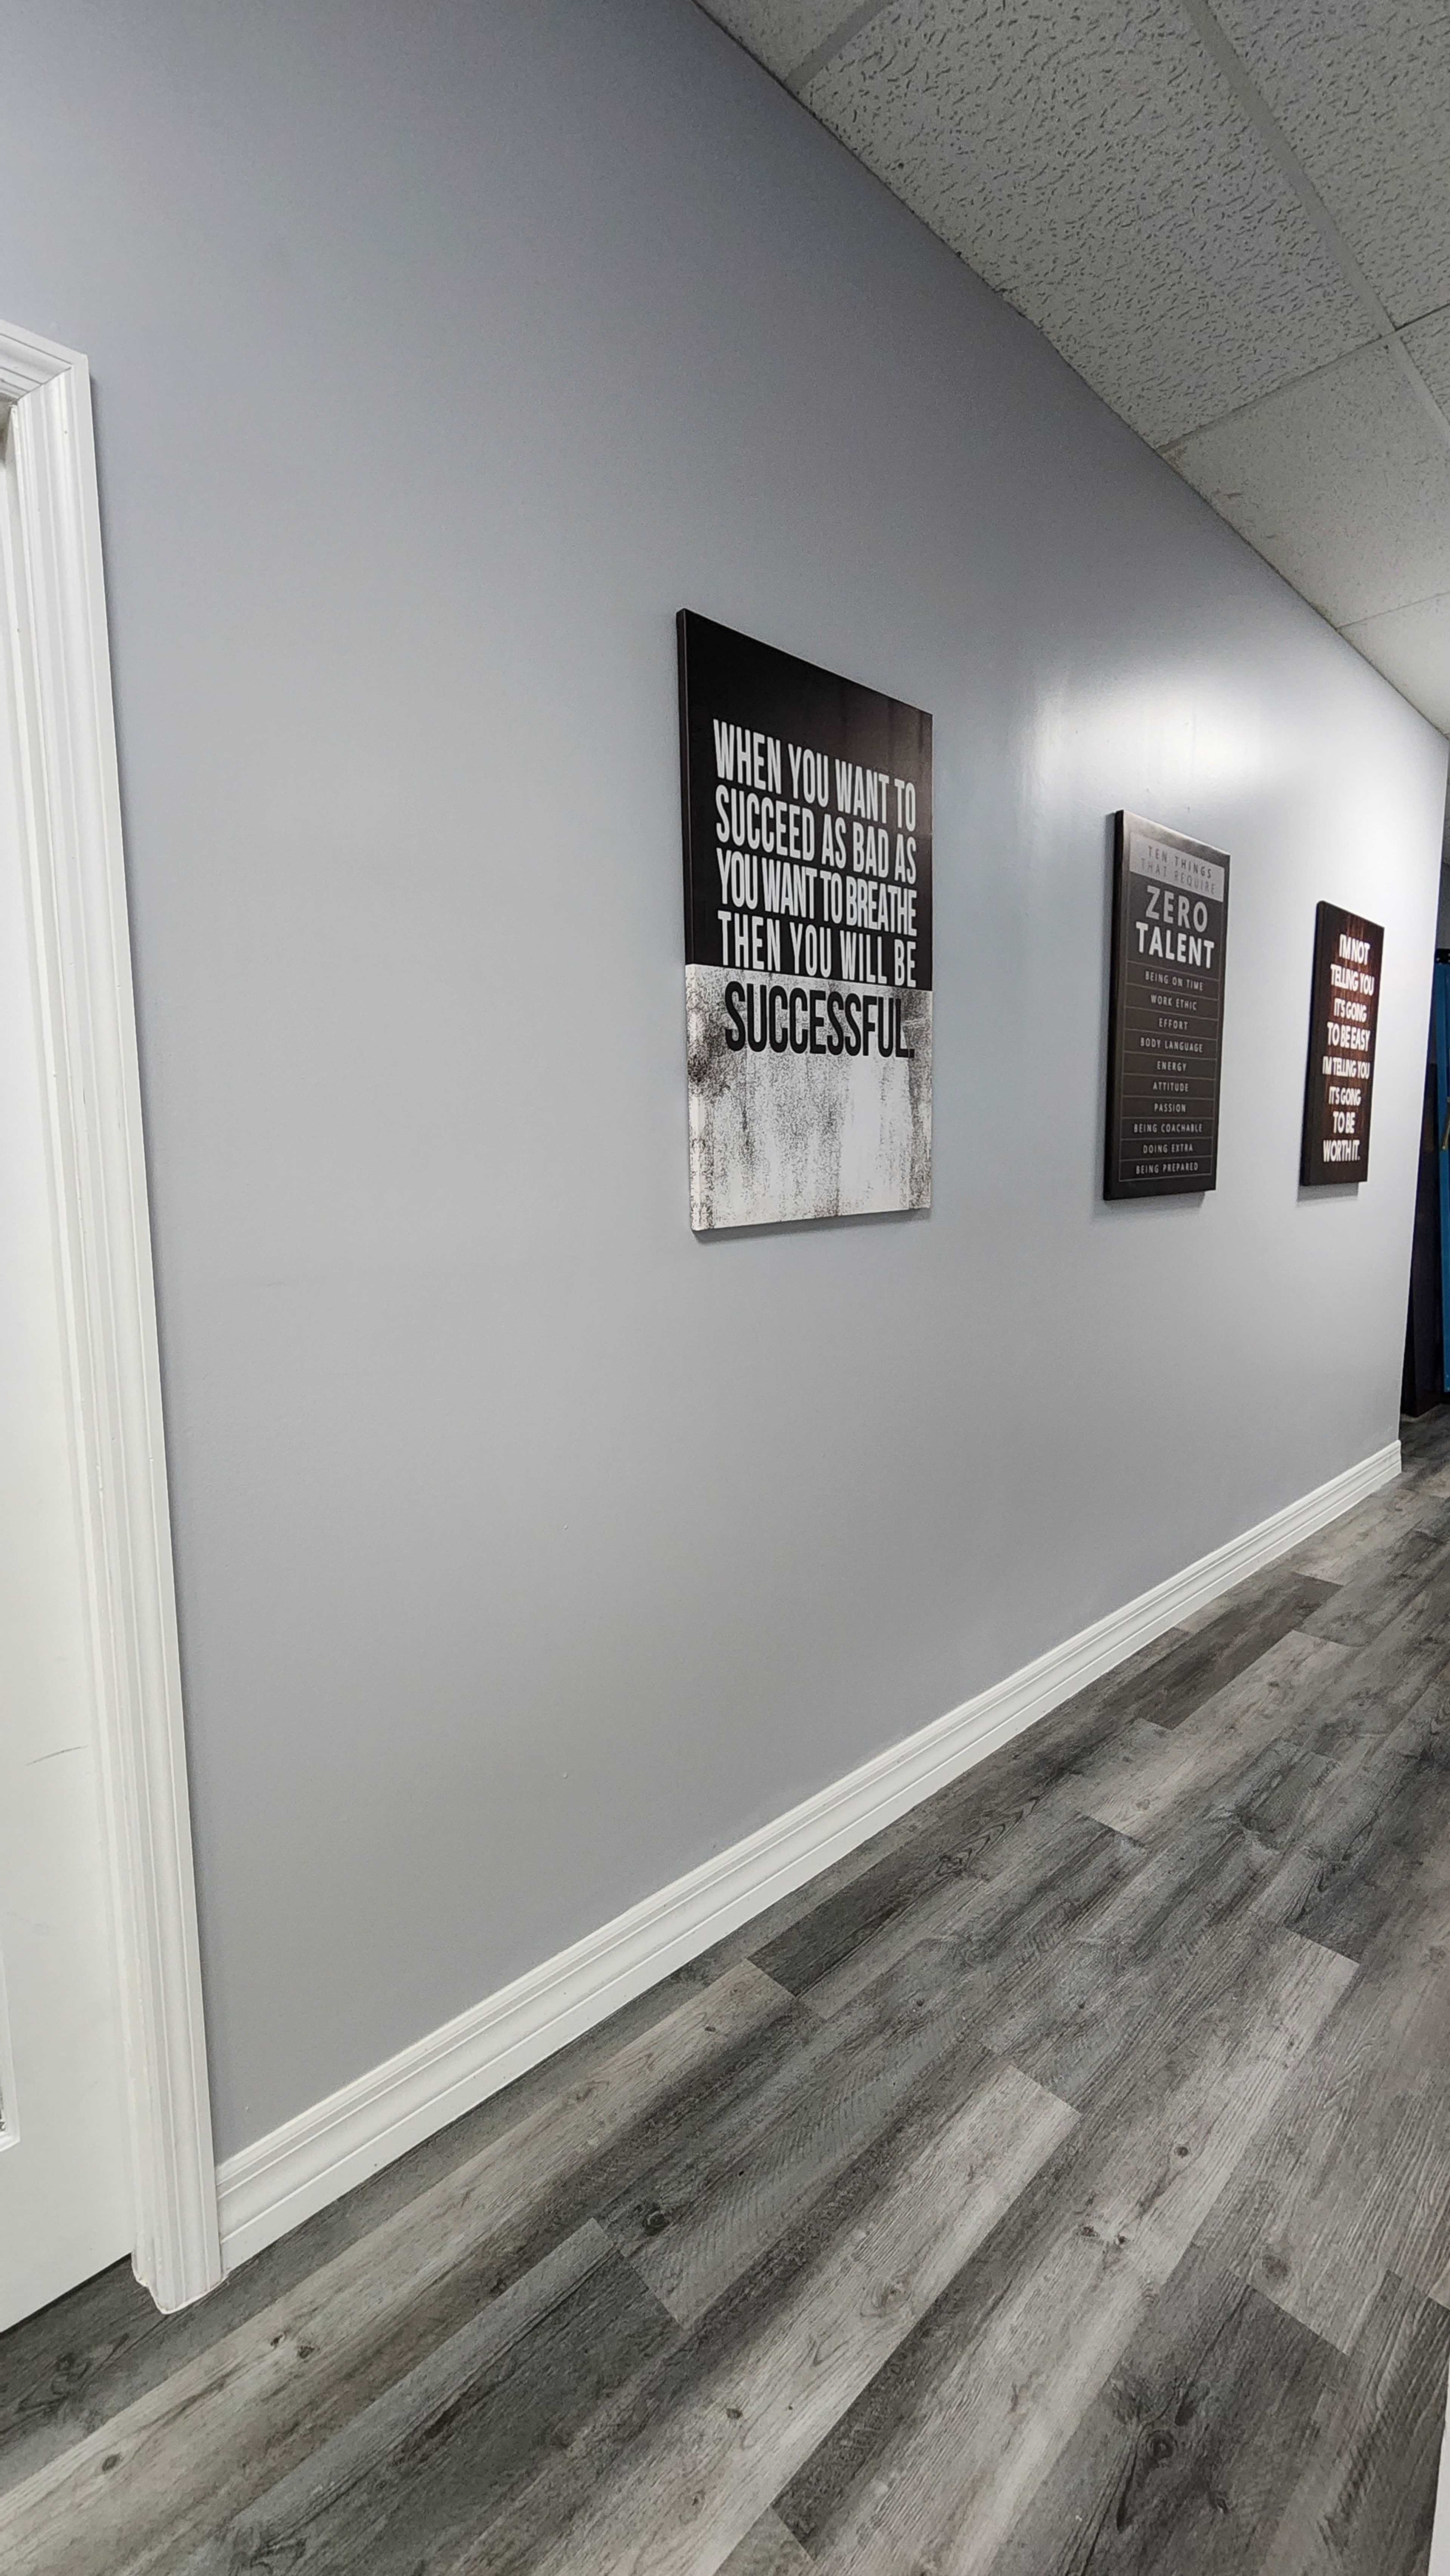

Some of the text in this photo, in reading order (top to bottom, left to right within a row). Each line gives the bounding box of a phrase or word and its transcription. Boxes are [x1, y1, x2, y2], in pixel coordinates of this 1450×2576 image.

[713, 719, 916, 831] WHEN YOU WANT TO
[715, 784, 916, 884] SUCCEED AS BAD AS
[1148, 845, 1212, 878] TEN THINGS
[1141, 858, 1215, 894] THAT REQUIRE
[716, 847, 917, 936] YOU WANT TO BREATHE
[1146, 885, 1208, 932] ZERO
[718, 911, 916, 987] THEN YOU WILL BE
[1136, 921, 1214, 969] TALENT
[1351, 938, 1370, 965] NOT
[1145, 971, 1203, 991] BEING ON TIME
[1330, 964, 1374, 996] TELLING YOU
[1151, 994, 1197, 1010] WORK ETHIC
[1346, 1001, 1367, 1022] GOING
[725, 980, 914, 1058] SUCCESSFUL.
[1159, 1018, 1188, 1030] EFFORT
[1140, 1037, 1203, 1053] BODY LANGUAGE
[1327, 1022, 1370, 1051] TO BE EASY
[1157, 1060, 1187, 1071] ENERGY
[1333, 1057, 1356, 1077] TELLING
[1357, 1061, 1370, 1079] YOU
[1153, 1082, 1188, 1092] ATTITUDE
[1340, 1088, 1361, 1106] GOING
[1154, 1103, 1186, 1112] PASSION
[1134, 1124, 1202, 1133] BEING COACHABLE
[1333, 1111, 1355, 1133] TO BE
[1143, 1144, 1193, 1153] DOING EXTRA
[1323, 1140, 1361, 1162] WORTH IT.
[1136, 1162, 1198, 1174] BEING PREPARED
